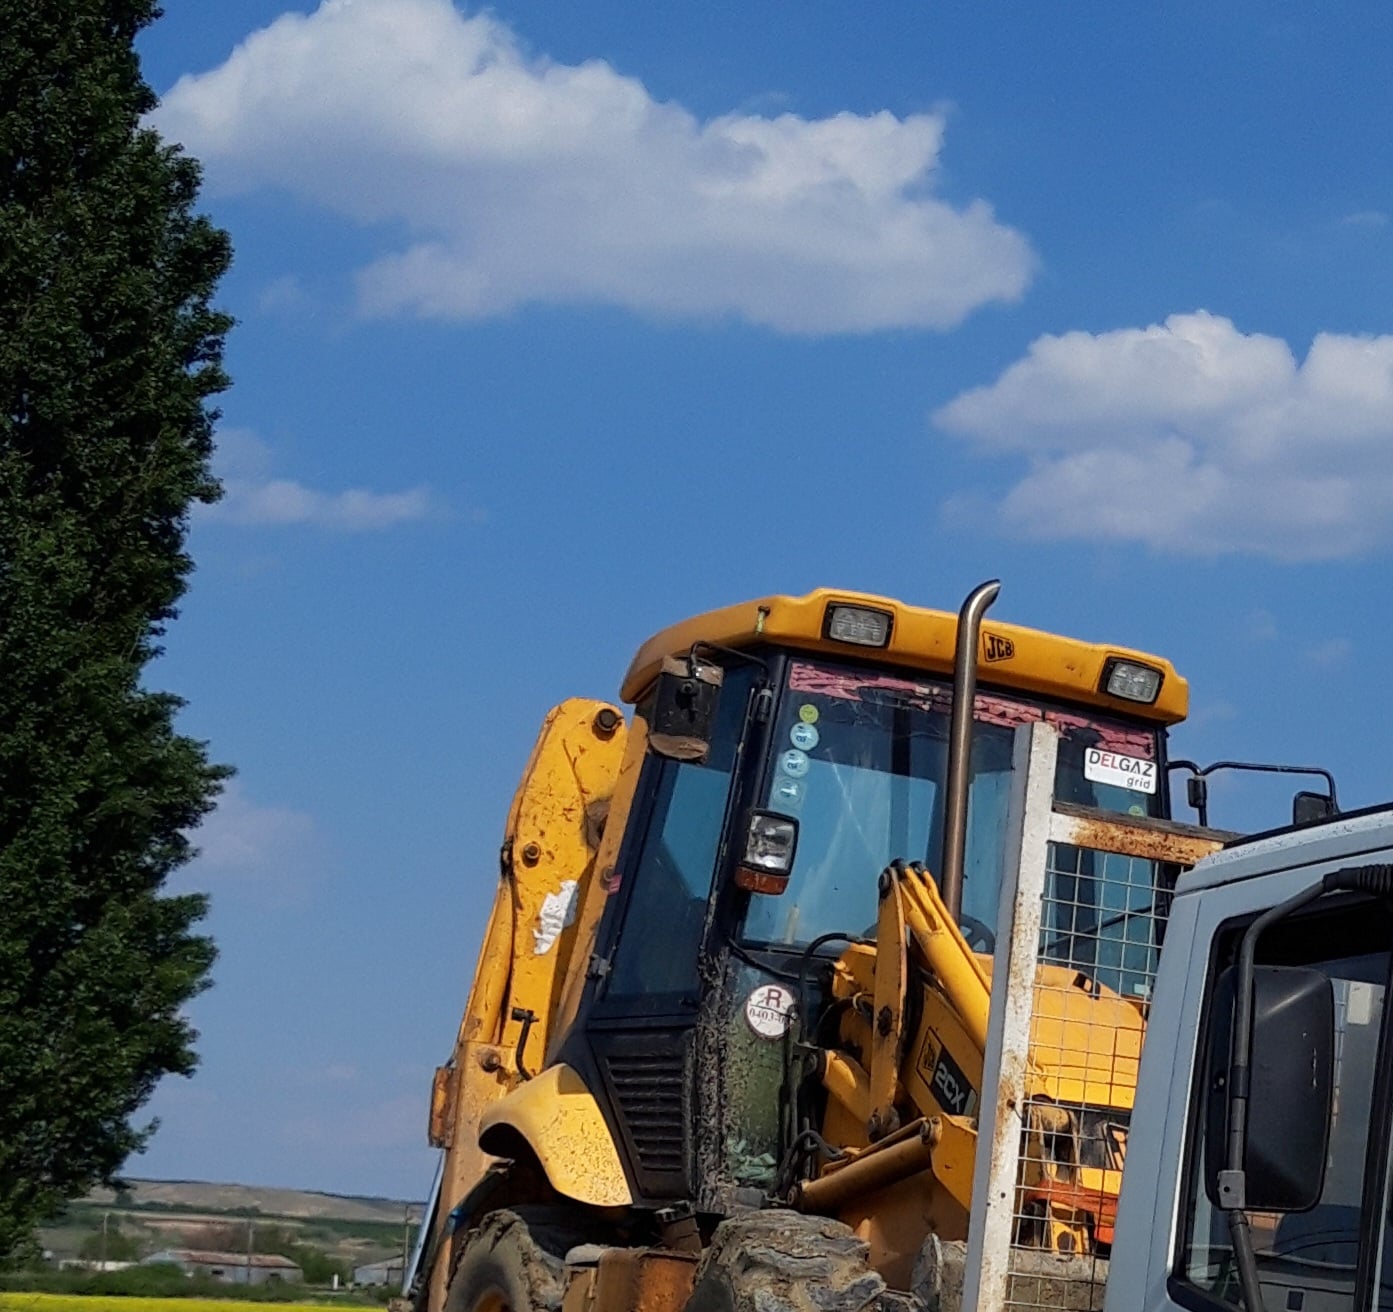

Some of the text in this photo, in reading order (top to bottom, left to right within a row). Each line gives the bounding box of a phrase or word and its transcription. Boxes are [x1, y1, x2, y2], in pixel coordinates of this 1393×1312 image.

[987, 635, 1013, 660] JCB
[1089, 750, 1153, 777] DELGAZ
[1127, 776, 1151, 789] grid
[765, 988, 782, 1008] R
